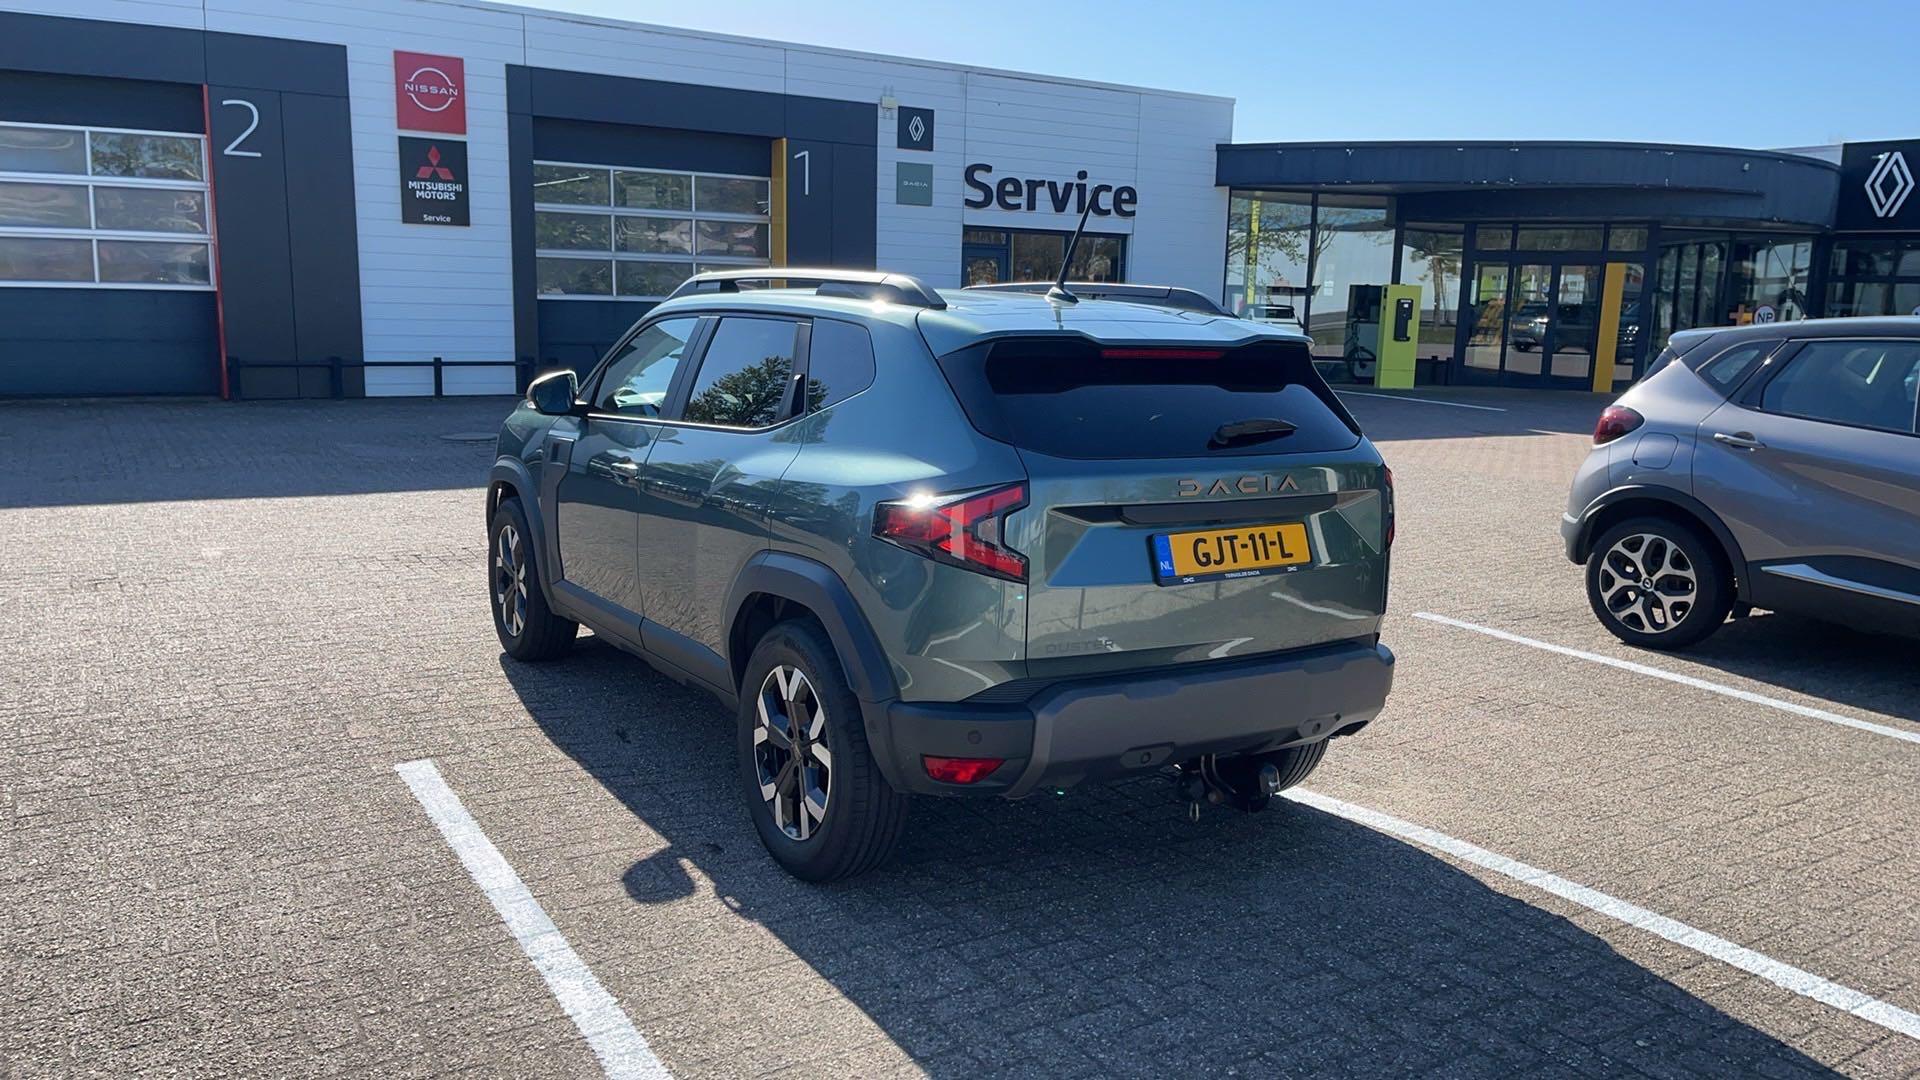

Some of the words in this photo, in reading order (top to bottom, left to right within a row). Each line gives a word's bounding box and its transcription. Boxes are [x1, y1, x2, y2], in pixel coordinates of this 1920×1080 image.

[405, 83, 458, 96] NISSAN
[222, 99, 262, 157] 2
[794, 150, 809, 195] 1
[408, 181, 463, 193] MITSUBISHI
[416, 190, 456, 201] MOTORS
[964, 163, 1138, 217] Service
[423, 214, 451, 223] Service
[1178, 474, 1299, 497] DACIA
[1193, 531, 1293, 567] GJT-11-L
[1160, 560, 1172, 570] NL
